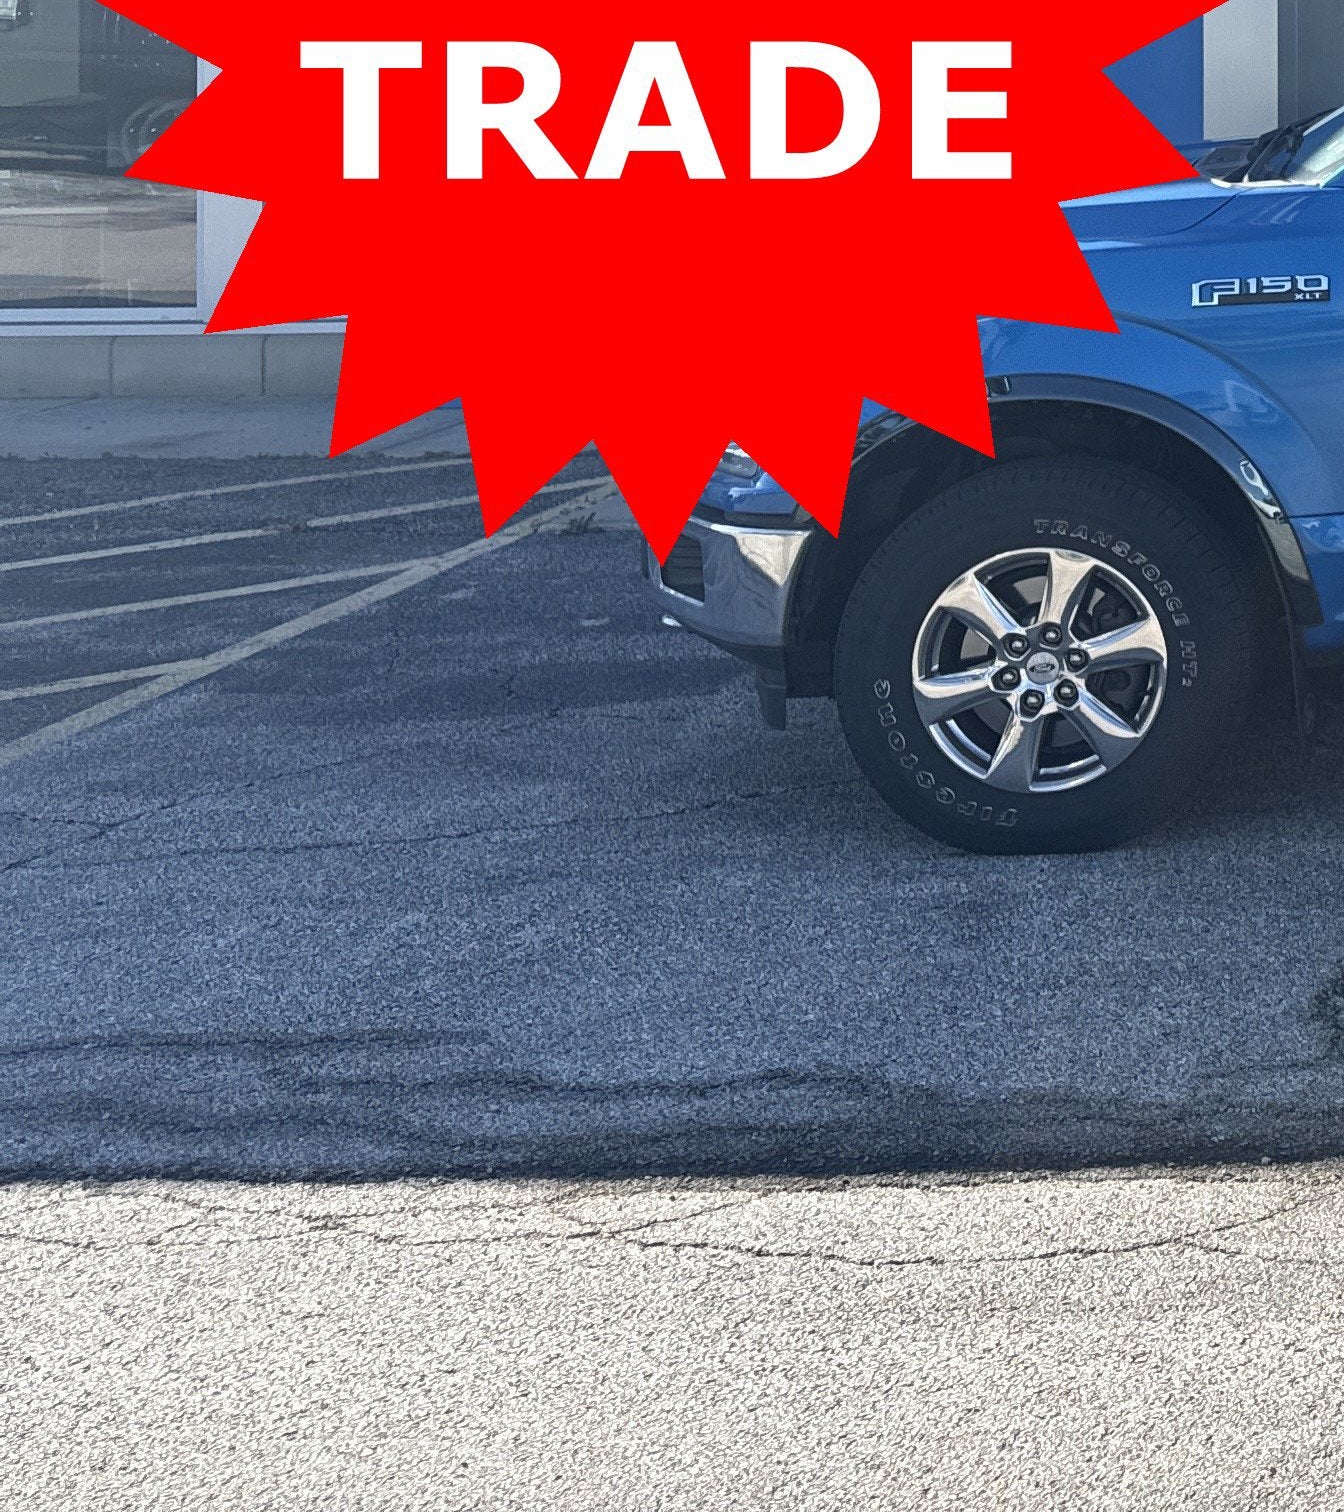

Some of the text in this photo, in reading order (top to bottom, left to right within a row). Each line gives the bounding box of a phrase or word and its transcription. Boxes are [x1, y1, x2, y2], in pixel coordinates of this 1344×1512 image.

[1192, 274, 1329, 307] F150
[1294, 292, 1323, 301] XLT
[1033, 518, 1191, 627] TRANSFORCE
